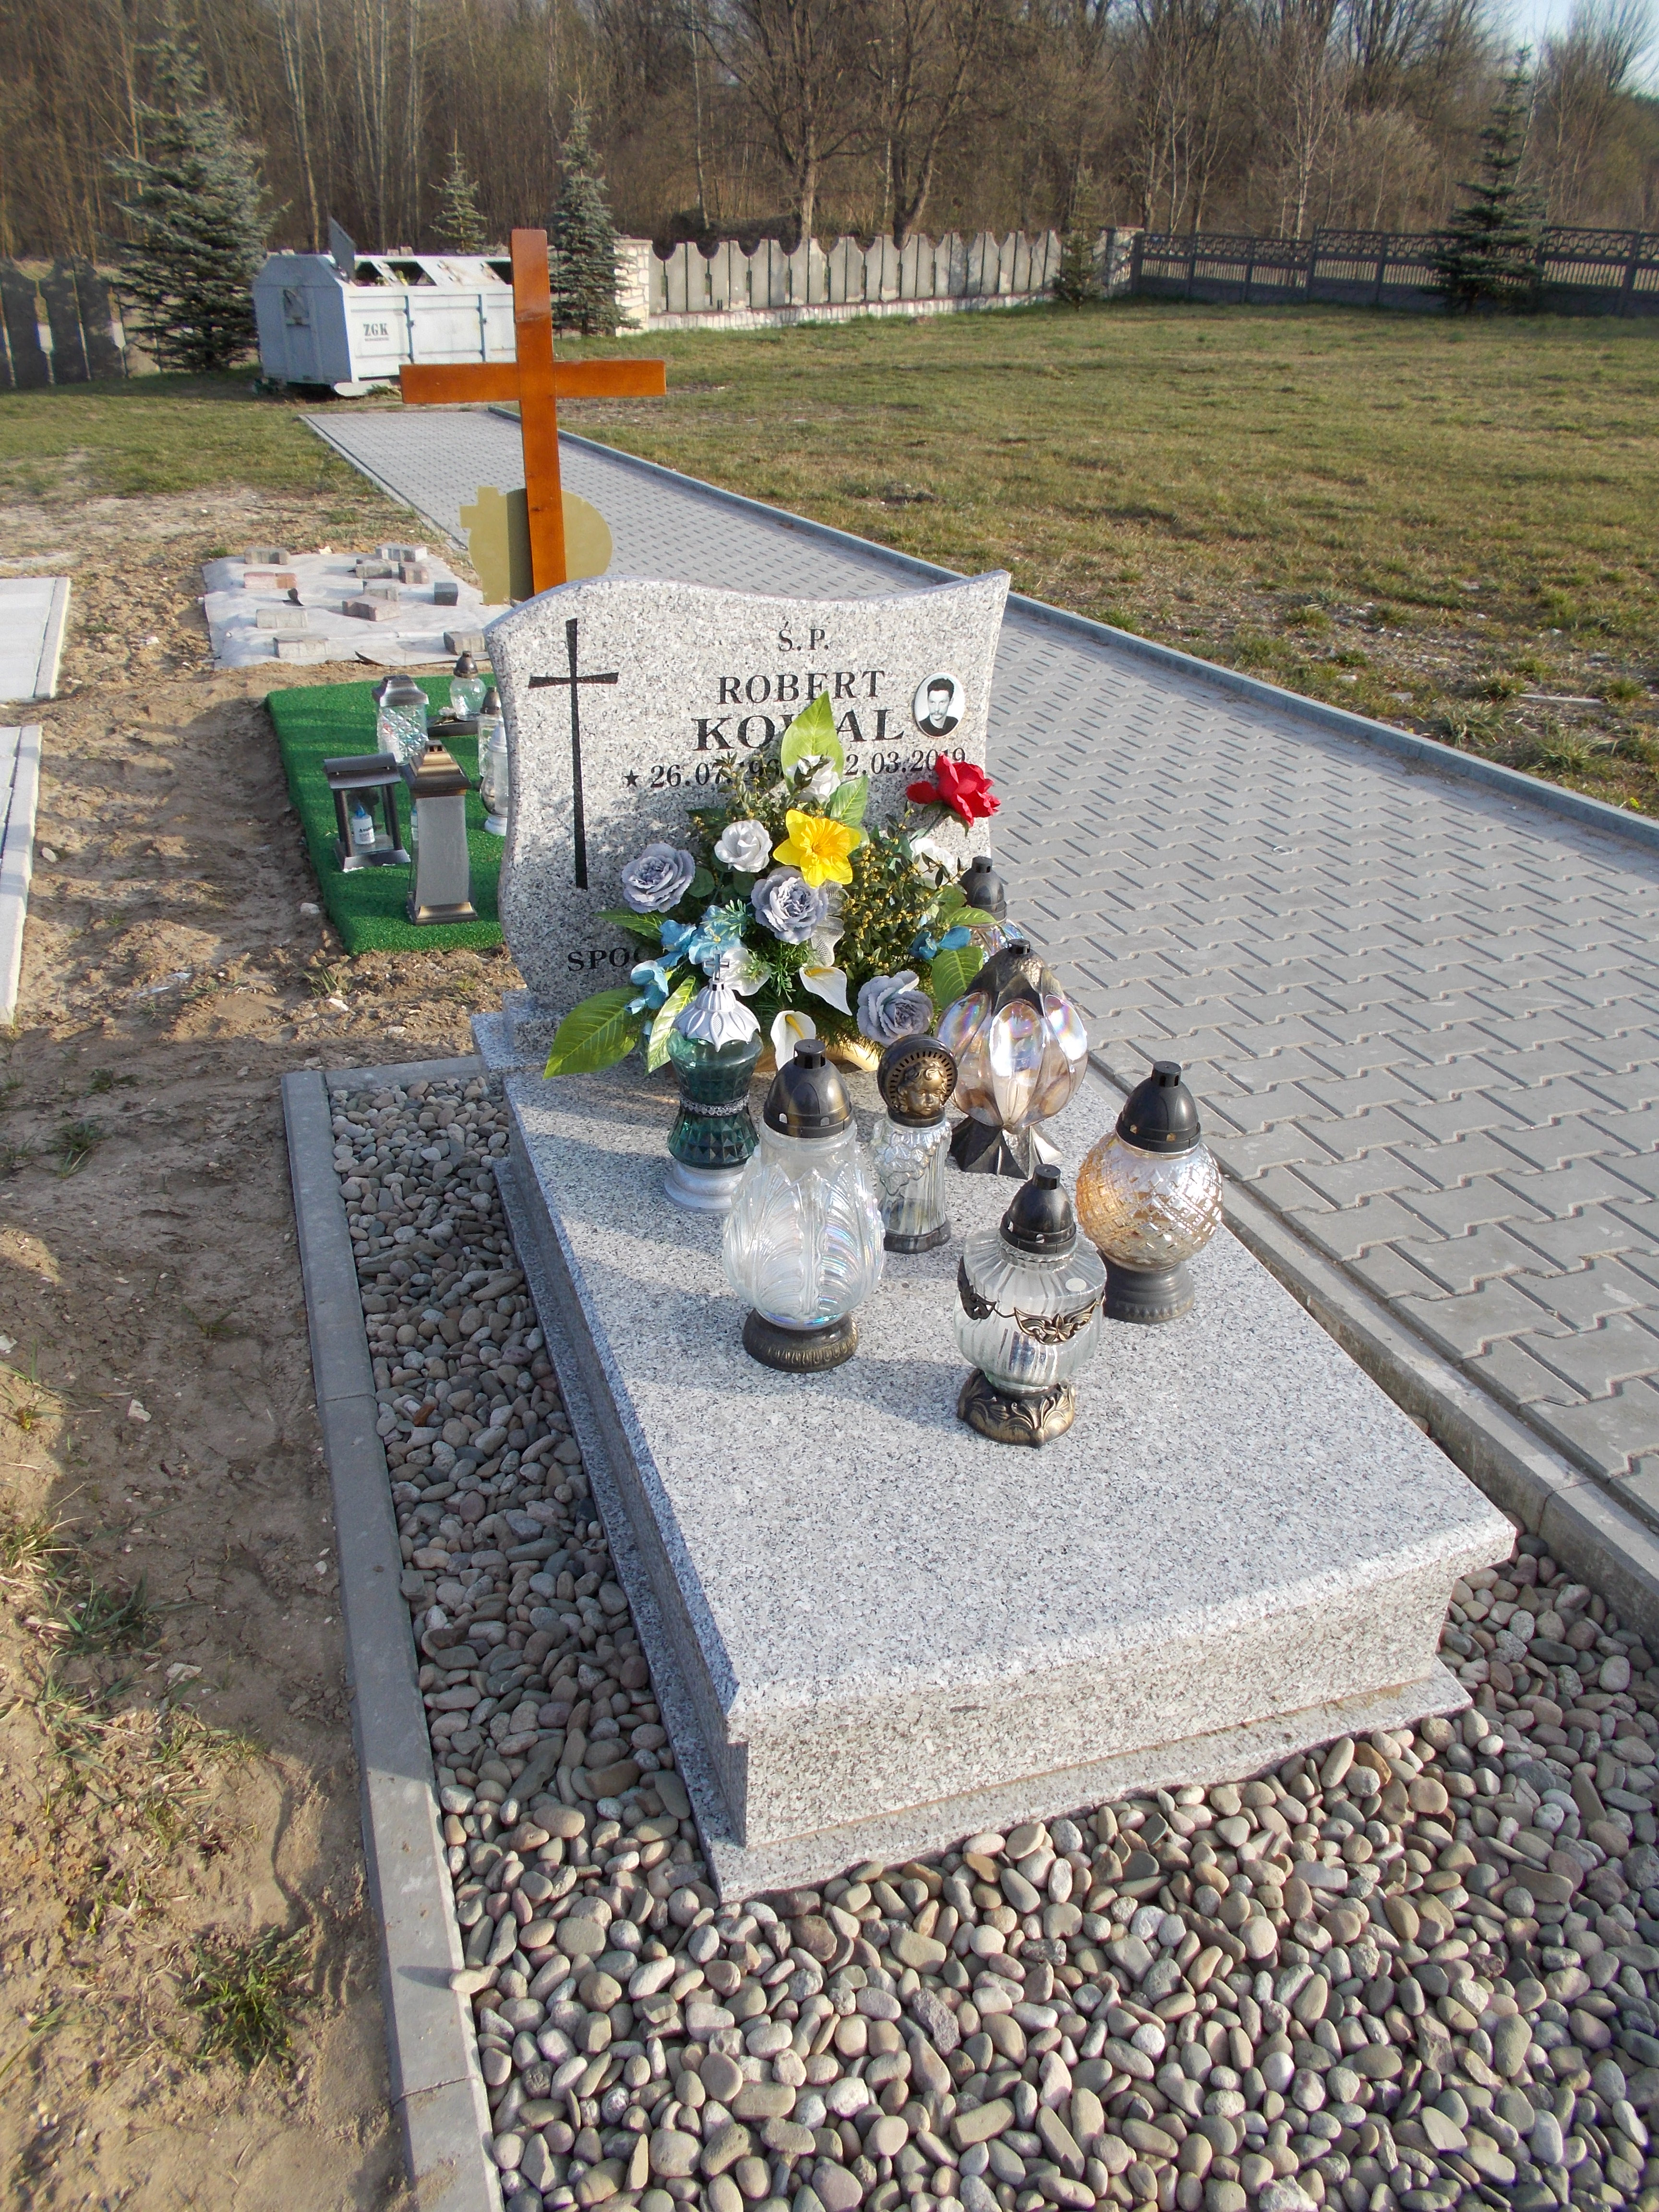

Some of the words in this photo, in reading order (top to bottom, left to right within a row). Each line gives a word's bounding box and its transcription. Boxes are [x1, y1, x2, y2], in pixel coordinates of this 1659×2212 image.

[363, 323, 389, 336] ZGK
[717, 671, 885, 704] ROBERT
[691, 709, 904, 751] KOAL
